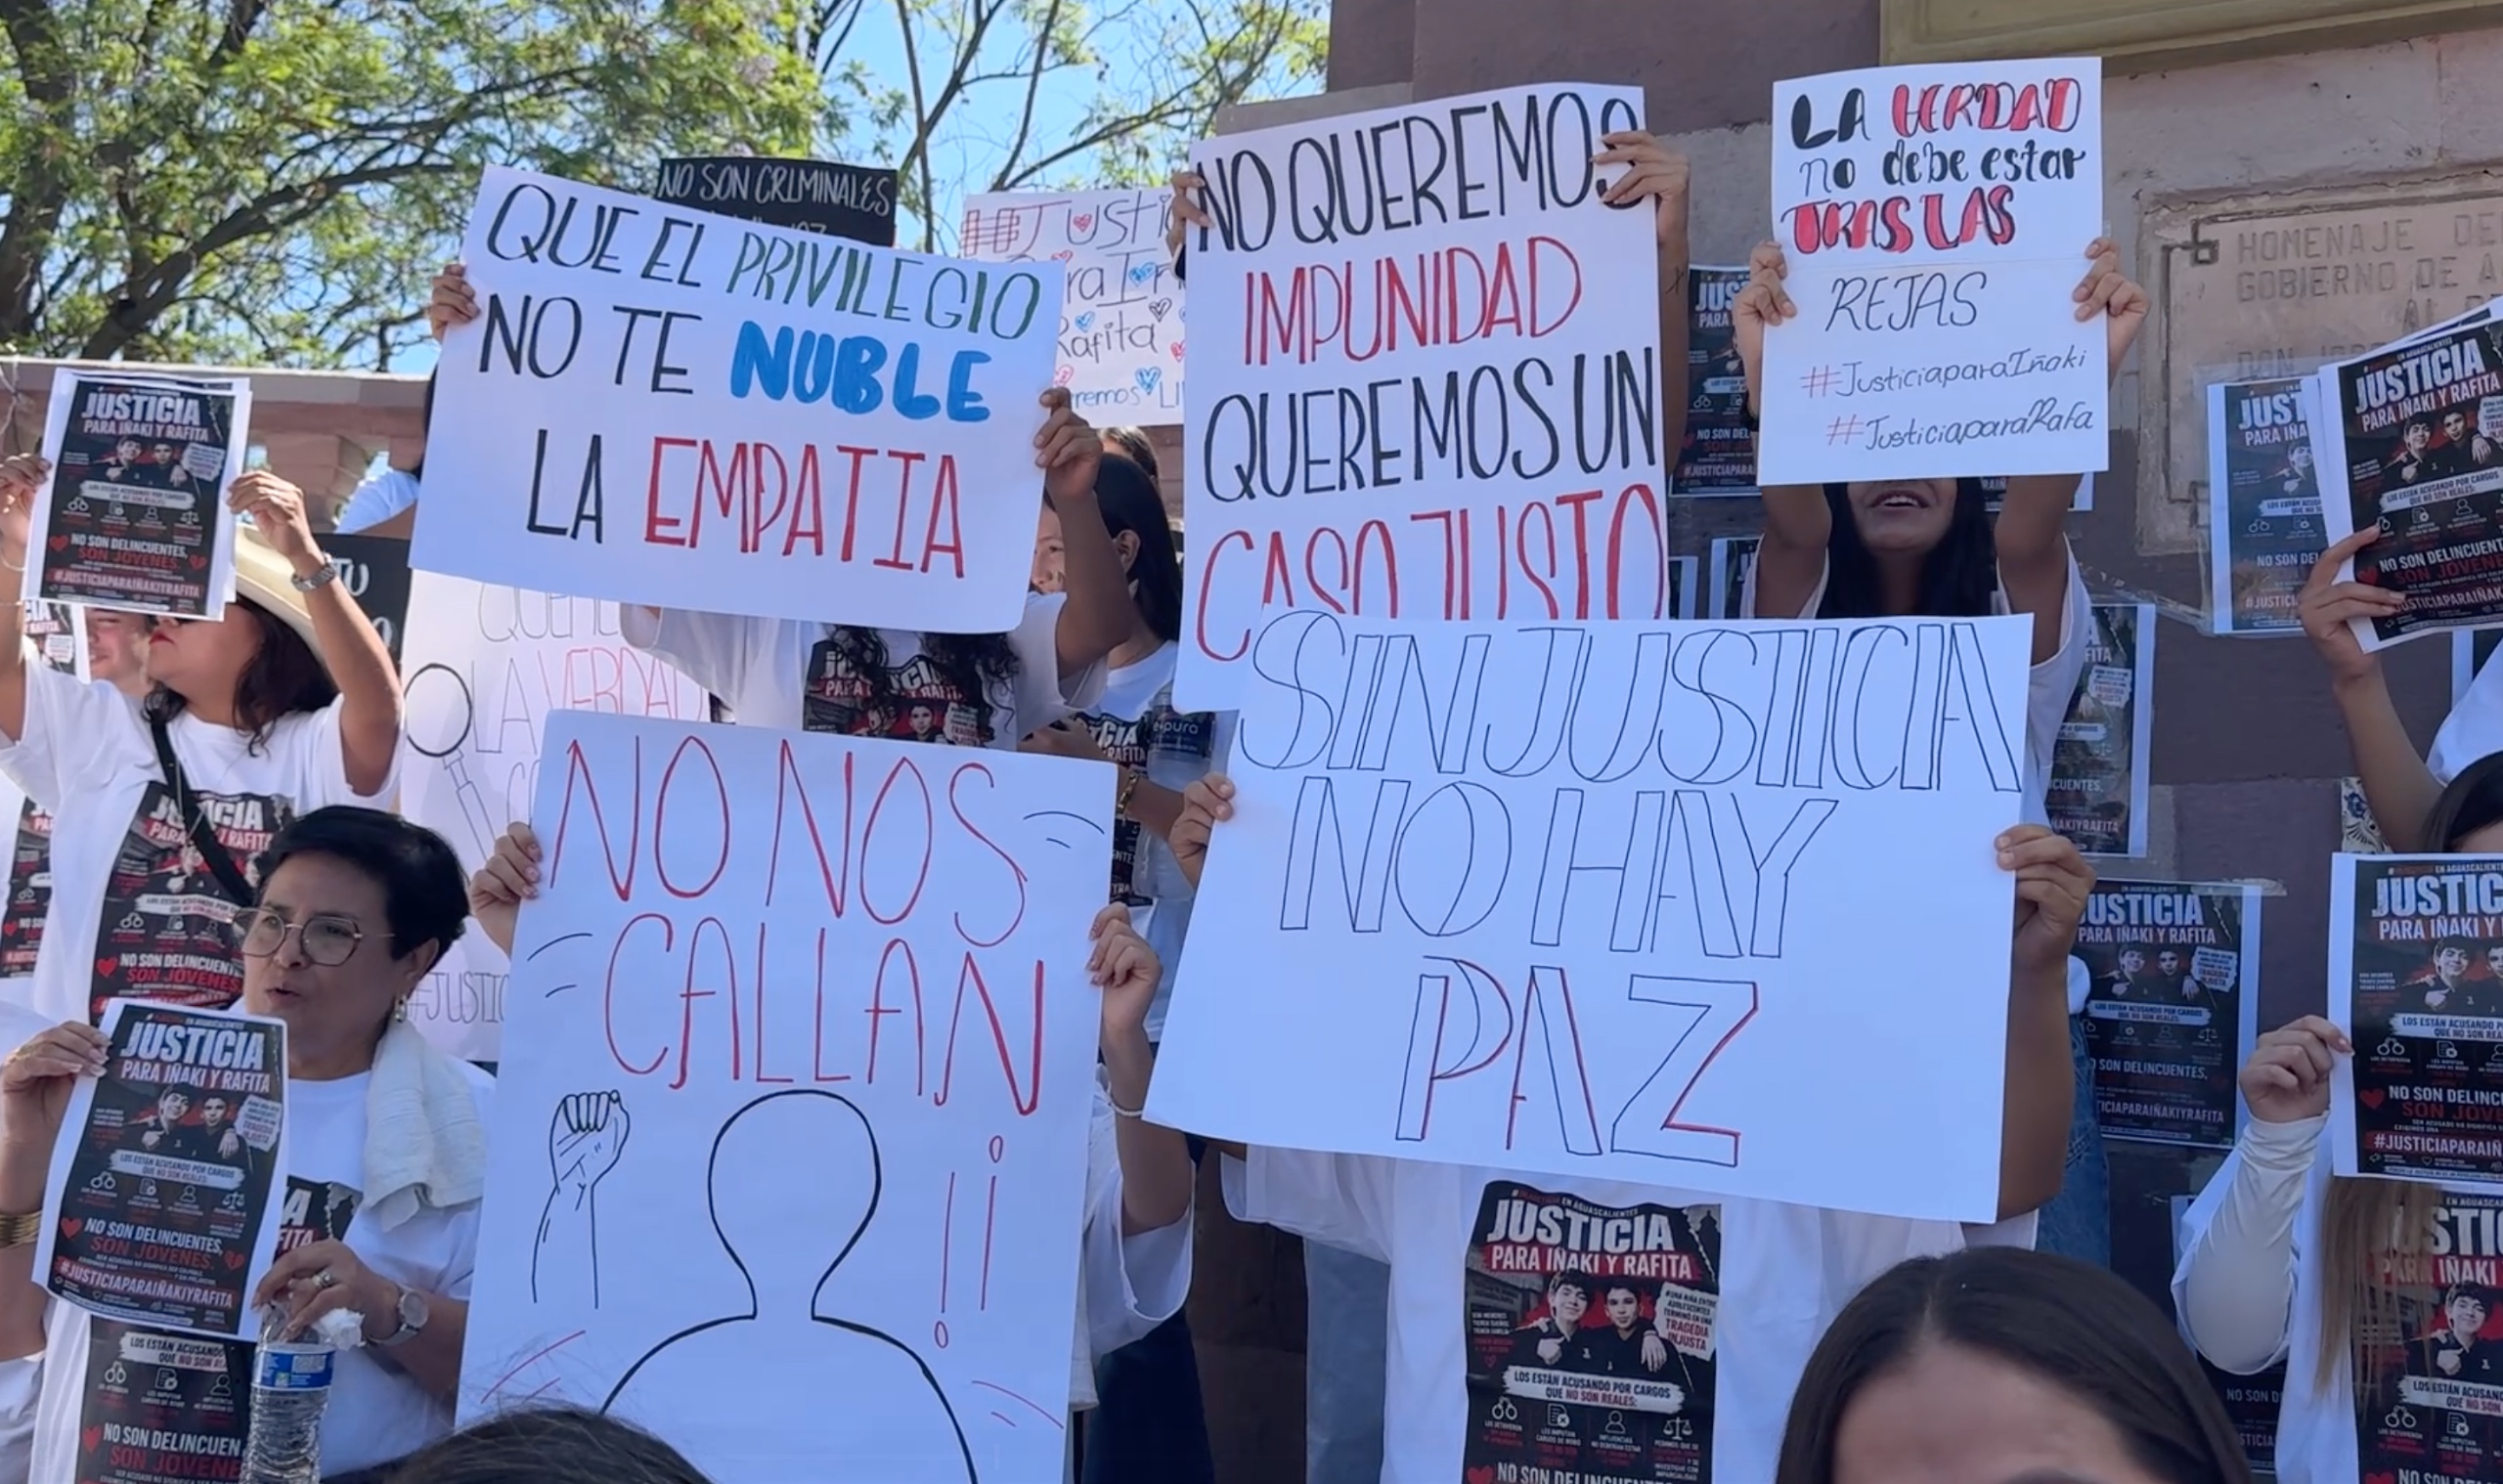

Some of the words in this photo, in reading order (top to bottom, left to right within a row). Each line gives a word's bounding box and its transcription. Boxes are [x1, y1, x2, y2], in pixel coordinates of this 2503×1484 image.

[1790, 87, 1870, 150] LA
[1891, 77, 2082, 138] VERDAD
[1799, 155, 1857, 196] no
[1882, 139, 1969, 185] debe
[1981, 139, 2086, 183] estar
[658, 163, 694, 197] NO
[700, 162, 751, 201] SON
[756, 163, 890, 217] CRIMINALES
[1196, 150, 1277, 252] NO
[1779, 194, 1914, 255] TRAS
[1921, 184, 2015, 250] LAS
[2237, 217, 2415, 264] HOMENAJE
[487, 183, 639, 275] QUE
[640, 217, 706, 288] EL
[725, 232, 1041, 340] PRIVILEGIO
[2236, 261, 2395, 304] GOBIERNO
[2416, 255, 2459, 291] DE
[1245, 236, 1582, 367] IMPUNIDAD
[1824, 272, 1989, 332] REJAS
[1698, 313, 1730, 328] PARA
[478, 293, 583, 379] NO
[612, 304, 703, 395] TE
[730, 320, 991, 423] NUBLE
[2355, 338, 2486, 415] JUSTICIA
[81, 392, 201, 426] JUSTICIA
[2362, 410, 2397, 433] PARA
[2398, 391, 2437, 420] IÑAKI
[2438, 388, 2447, 408] Y
[2450, 371, 2502, 404] RAFITA
[84, 419, 116, 435] PARA
[155, 424, 166, 438] Y
[165, 424, 209, 443] RAFITA
[1204, 357, 1560, 502] QUEREMOS
[1573, 347, 1656, 474] UN
[1697, 429, 1712, 441] NO
[1712, 428, 1732, 440] SON
[2245, 429, 2282, 447] PARA
[1684, 463, 1757, 478] #JUSTICIAPARA
[526, 428, 604, 545] LA
[643, 436, 965, 579] EMPATIA
[70, 533, 86, 546] NO
[89, 535, 109, 549] SON
[2257, 555, 2272, 566] NO
[2275, 553, 2298, 565] SON
[2379, 559, 2398, 574] NO
[2399, 552, 2426, 569] SON
[2427, 536, 2503, 565] DELINCUENT
[1196, 519, 1399, 662] CASO
[1411, 483, 1666, 621] JUSTO
[471, 658, 538, 756] LA
[1240, 610, 1490, 774] SIN
[1483, 622, 2021, 793] JUSTICIA
[149, 821, 186, 845] PARA
[549, 735, 730, 902] NO
[765, 737, 1030, 947] NOS
[1280, 777, 1512, 937] NO
[1530, 788, 1838, 959] HAY
[2078, 927, 2113, 943] PARA
[2116, 924, 2154, 943] IÑAKI
[2157, 928, 2167, 943] Y
[2169, 926, 2217, 944] RAFITA
[2379, 919, 2425, 940] PARA
[2430, 915, 2480, 938] IÑAKI
[2484, 917, 2496, 938] Y
[120, 953, 136, 967] NO
[139, 953, 161, 968] SON
[126, 968, 159, 982] SON
[603, 912, 1046, 1115] CALLAN
[2402, 1017, 2418, 1026] LOS
[2448, 1018, 2494, 1030] ACUSANDO
[119, 1021, 266, 1071] JUSTICIA
[2434, 1027, 2450, 1038] QUE
[2452, 1029, 2466, 1038] NO
[2467, 1029, 2484, 1039] SON
[1395, 956, 1758, 1167] PAZ
[2098, 1058, 2121, 1072] SON
[121, 1060, 161, 1082] PARA
[163, 1062, 205, 1088] IÑAKI
[209, 1069, 221, 1087] Y
[221, 1069, 271, 1094] RAFITA
[2388, 1085, 2409, 1100] NO
[2413, 1086, 2443, 1103] SON
[2402, 1102, 2444, 1119] SON
[2374, 1132, 2503, 1157] #JUSTICIAPARAIÑ
[1561, 1197, 1572, 1206] EN
[1573, 1200, 1639, 1218] AGUASCALIENTES
[2446, 1197, 2458, 1205] EN
[84, 1218, 106, 1235] NO
[107, 1221, 135, 1240] SON
[134, 1224, 224, 1256] DELINCUENTES,
[1486, 1198, 1676, 1254] JUSTICIA
[90, 1237, 130, 1256] SON
[1491, 1244, 1540, 1271] PARA
[1547, 1245, 1601, 1275] IÑAKI
[1604, 1254, 1619, 1275] Y
[1623, 1253, 1692, 1281] RAFITA
[2438, 1255, 2496, 1287] IÑAKI
[1666, 1318, 1710, 1337] TRAGEDIA
[1668, 1331, 1707, 1351] INJUSTA
[130, 1335, 146, 1349] LOS
[158, 1352, 177, 1365] QUE
[178, 1354, 193, 1367] NO
[194, 1355, 212, 1369] SON
[1515, 1371, 1531, 1384] LOS
[1561, 1375, 1611, 1392] ACUSANDO
[1612, 1380, 1632, 1394] POR
[1634, 1383, 1672, 1398] CARGOS
[1545, 1387, 1564, 1399] QUE
[1565, 1389, 1580, 1402] NO
[1581, 1390, 1601, 1404] SON
[2227, 1388, 2243, 1402] NO
[2246, 1388, 2268, 1403] SON
[2413, 1380, 2430, 1392] LOS
[2446, 1396, 2464, 1408] QUE
[2465, 1398, 2480, 1410] NO
[2481, 1401, 2501, 1414] SON
[103, 1421, 120, 1442] NO
[122, 1423, 149, 1448] SON
[151, 1429, 242, 1458] DELINCUEN
[110, 1444, 146, 1468] SON
[1497, 1461, 1516, 1483] NO
[1520, 1465, 1551, 1484] SON
